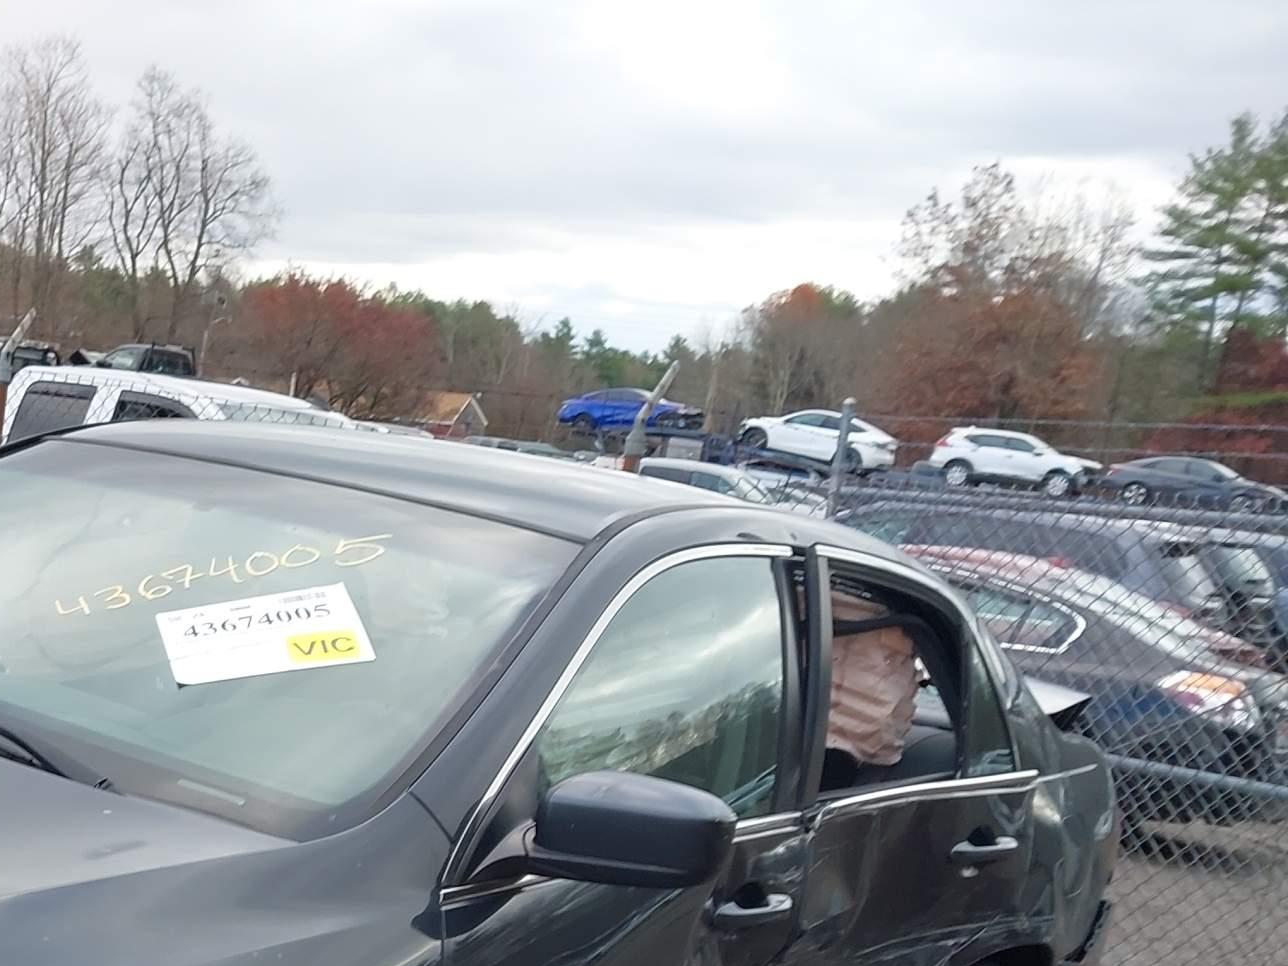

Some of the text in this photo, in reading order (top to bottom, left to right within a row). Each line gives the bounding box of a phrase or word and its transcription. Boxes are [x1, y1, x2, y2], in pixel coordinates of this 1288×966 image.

[55, 533, 393, 616] 43674005
[183, 603, 332, 638] 43674005
[292, 636, 355, 656] VIC
